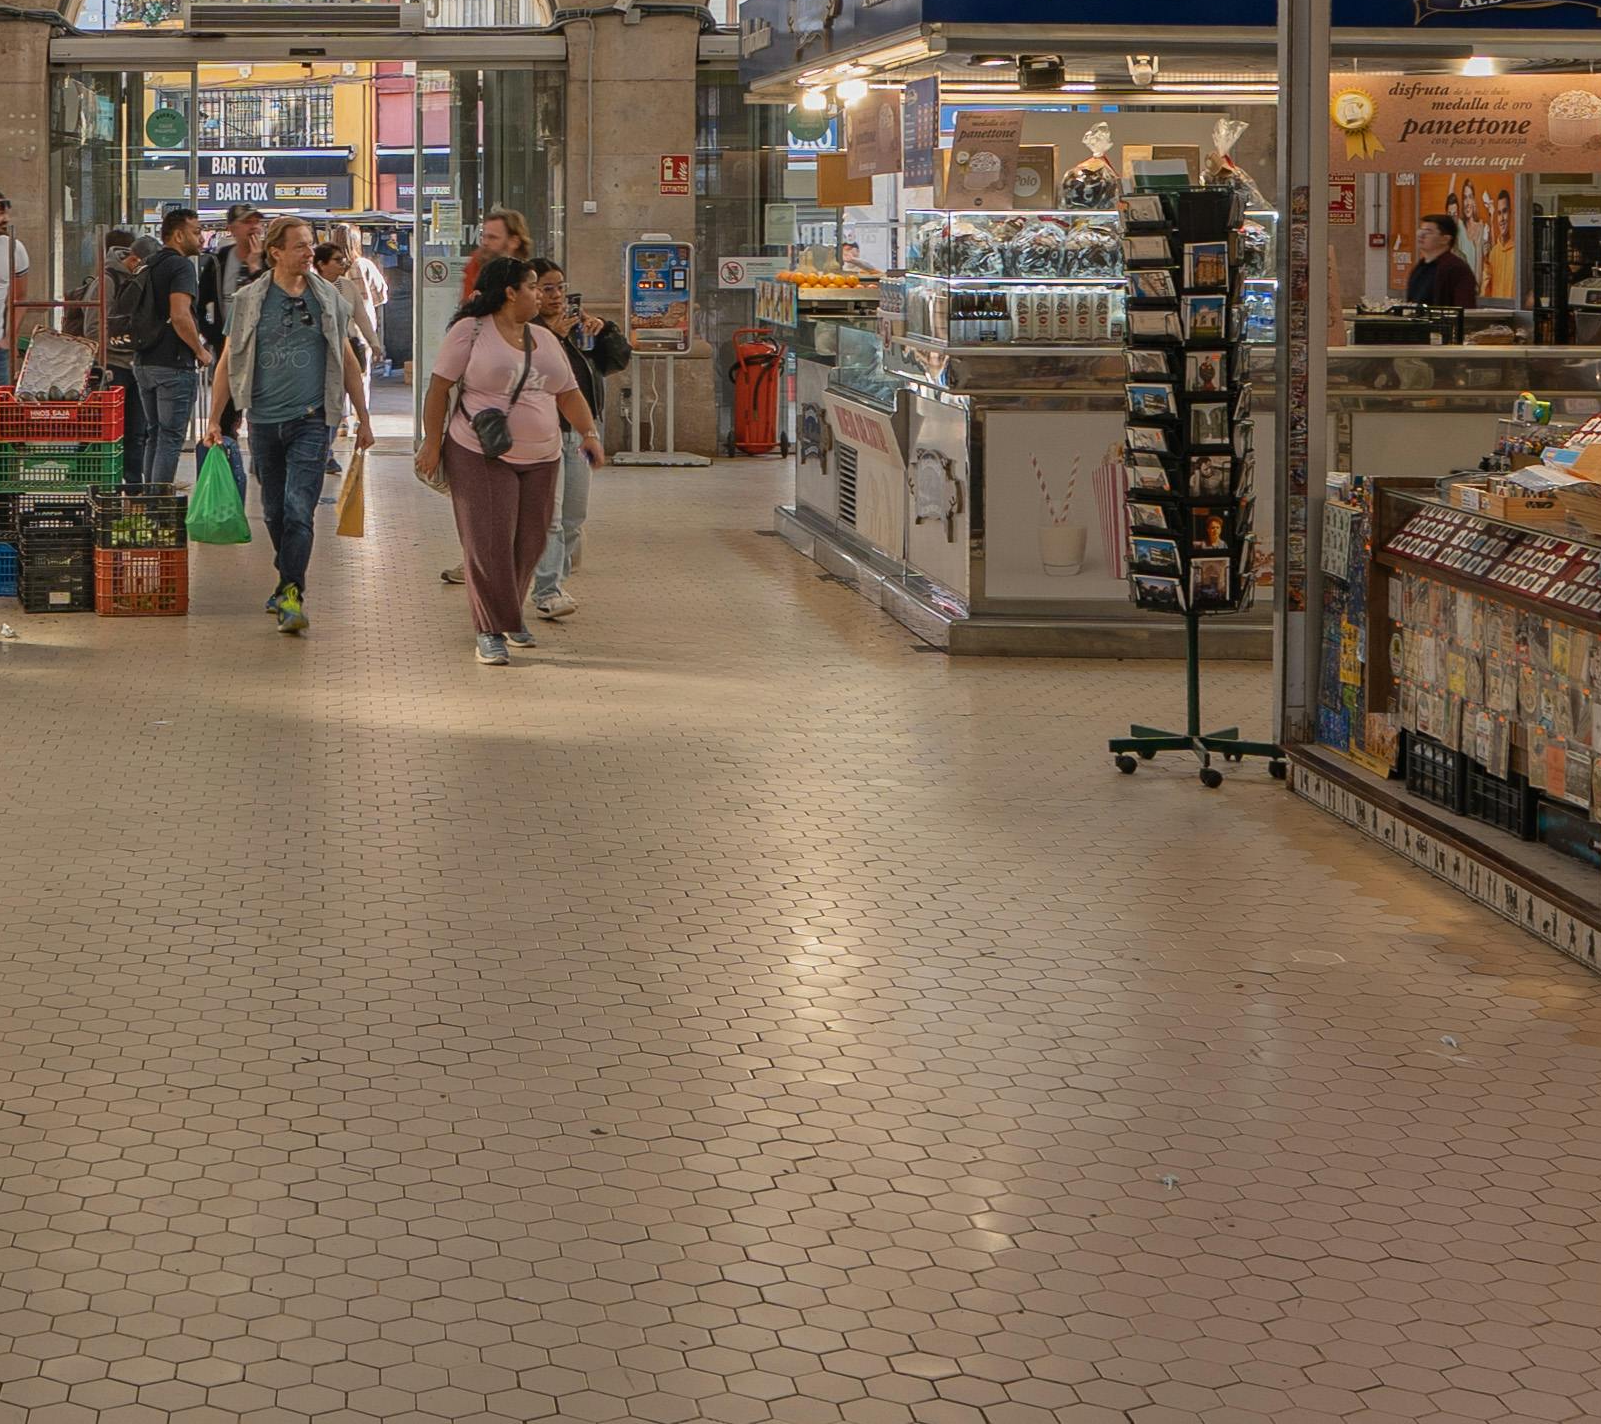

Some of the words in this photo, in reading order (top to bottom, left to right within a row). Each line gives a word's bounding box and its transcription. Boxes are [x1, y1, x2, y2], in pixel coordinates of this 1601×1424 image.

[1388, 81, 1450, 101] disfruta
[1431, 96, 1490, 111] medalla
[1493, 97, 1508, 111] de
[1511, 101, 1533, 111] oro
[958, 128, 1018, 143] panettone
[1398, 116, 1532, 143] panettone
[212, 157, 237, 175] BAR
[242, 157, 266, 175] FOX
[1424, 153, 1442, 166] de
[1446, 155, 1488, 167] venta
[1492, 152, 1527, 170] aquí
[215, 183, 241, 201] BAR
[244, 183, 269, 201] FOX
